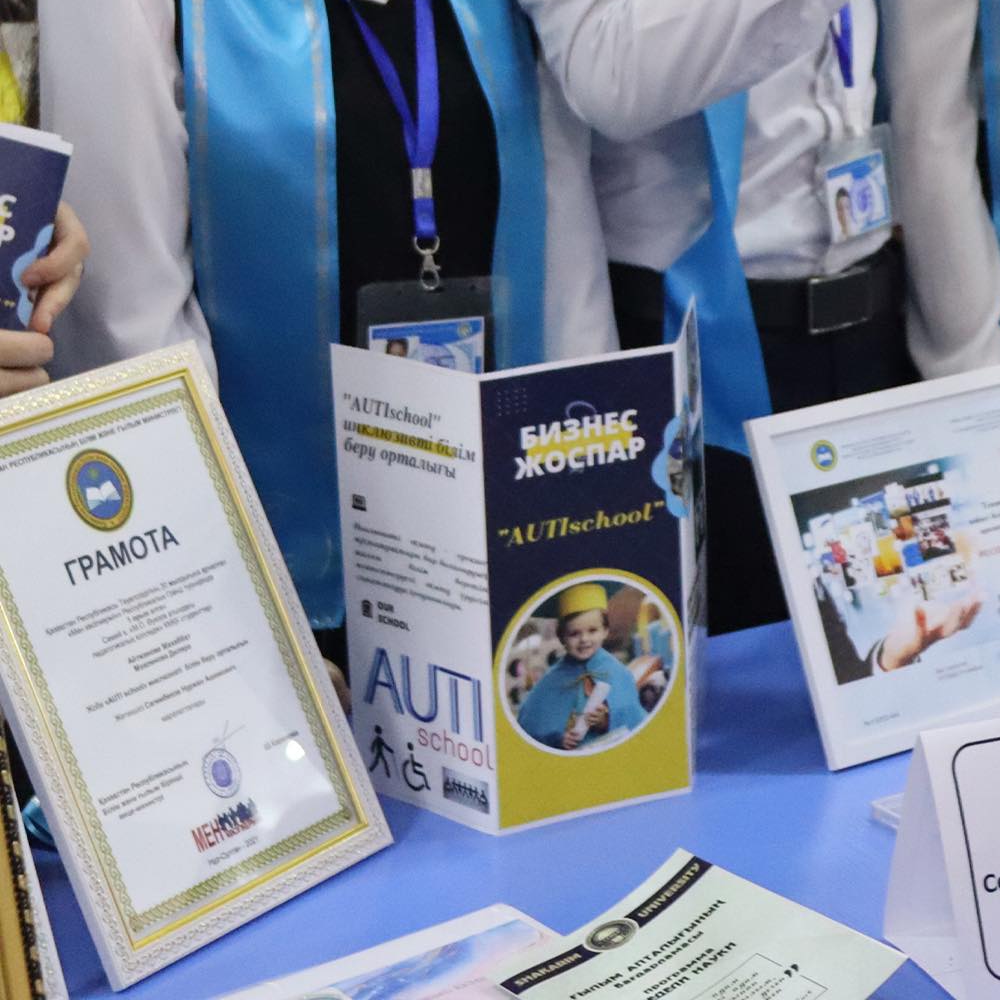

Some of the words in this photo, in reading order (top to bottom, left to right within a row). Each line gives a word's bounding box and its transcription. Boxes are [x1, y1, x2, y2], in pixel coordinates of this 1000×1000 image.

[344, 437, 377, 461] беру
[519, 408, 638, 450] БИЗНЕС
[514, 436, 646, 480] ЖОСПАР
[62, 522, 180, 586] ГРАМОТА
[378, 601, 395, 612] OUR
[378, 614, 411, 631] SCHOOL
[364, 647, 484, 743] AUTI
[417, 727, 495, 770] school
[514, 952, 582, 987] SHAKARIM
[638, 862, 700, 918] UNIVERSITY
[691, 941, 737, 975] НАУКИ
